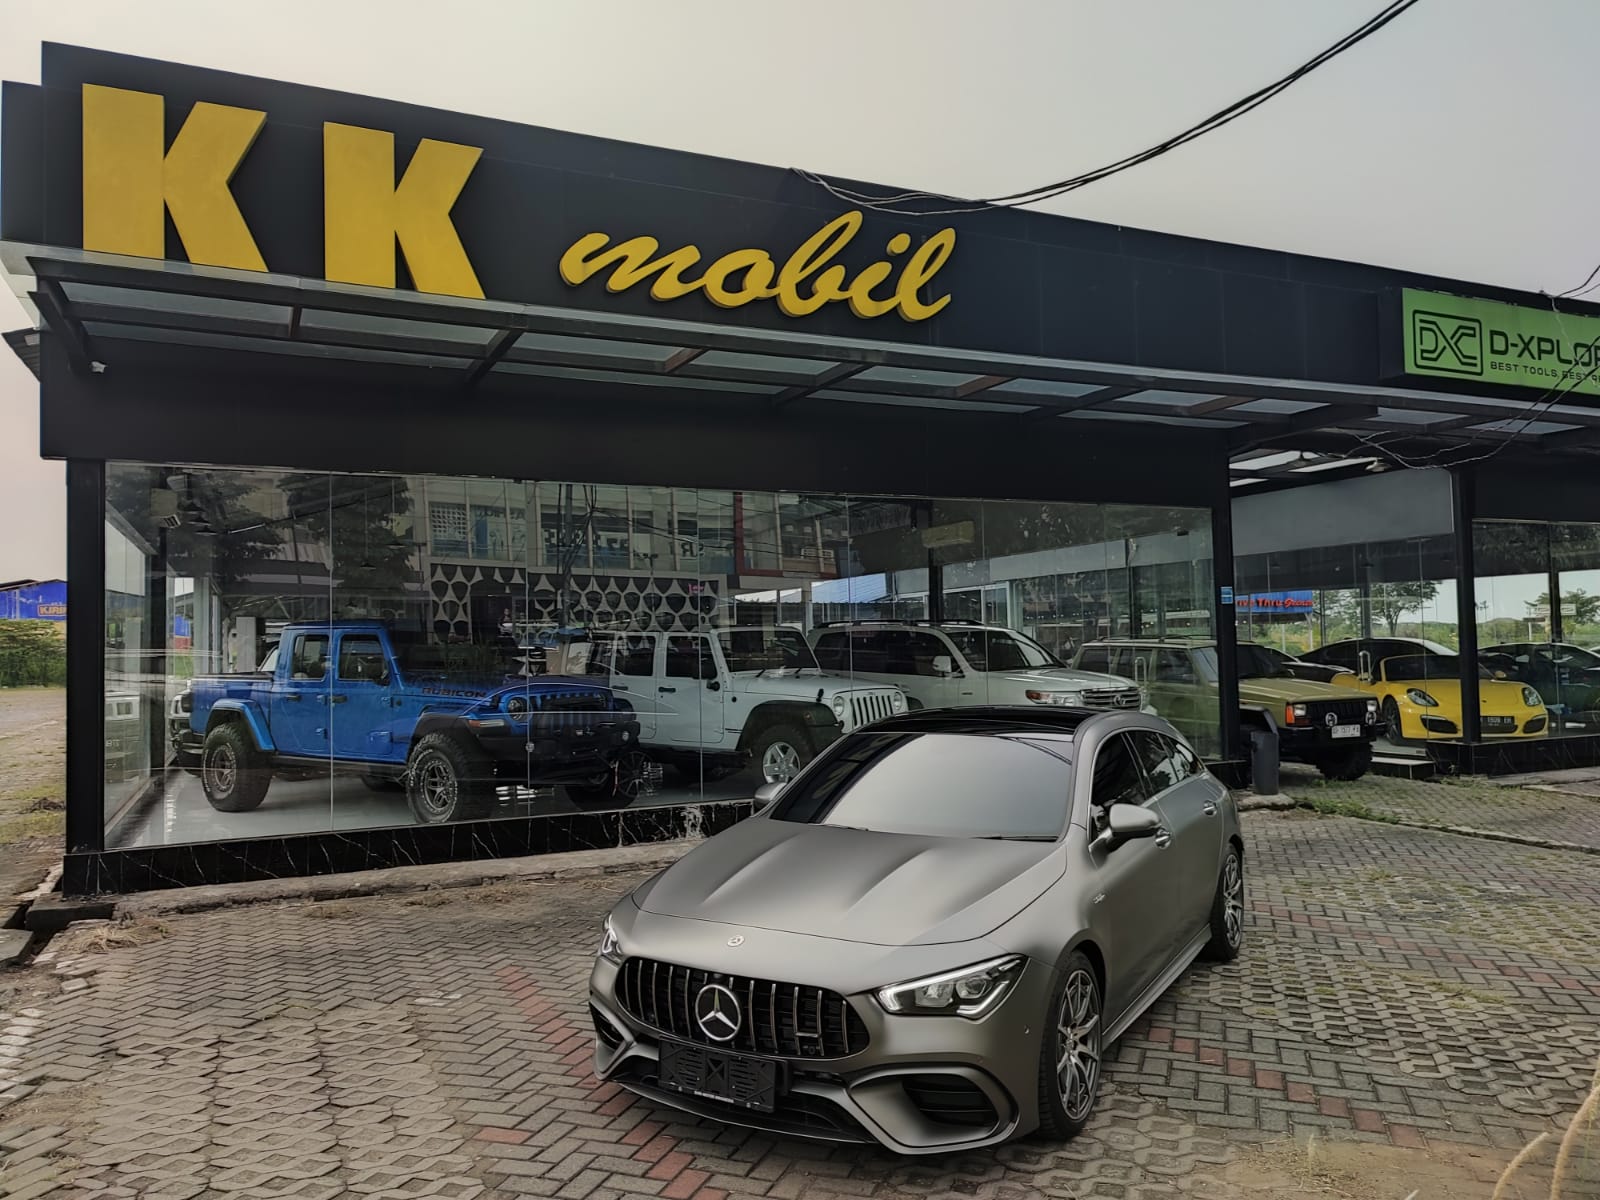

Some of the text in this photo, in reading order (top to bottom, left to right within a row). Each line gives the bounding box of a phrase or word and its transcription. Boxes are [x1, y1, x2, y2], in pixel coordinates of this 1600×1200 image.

[82, 83, 956, 321] KK mobil
[1490, 361, 1519, 373] BEST
[422, 687, 487, 698] RUBICON
